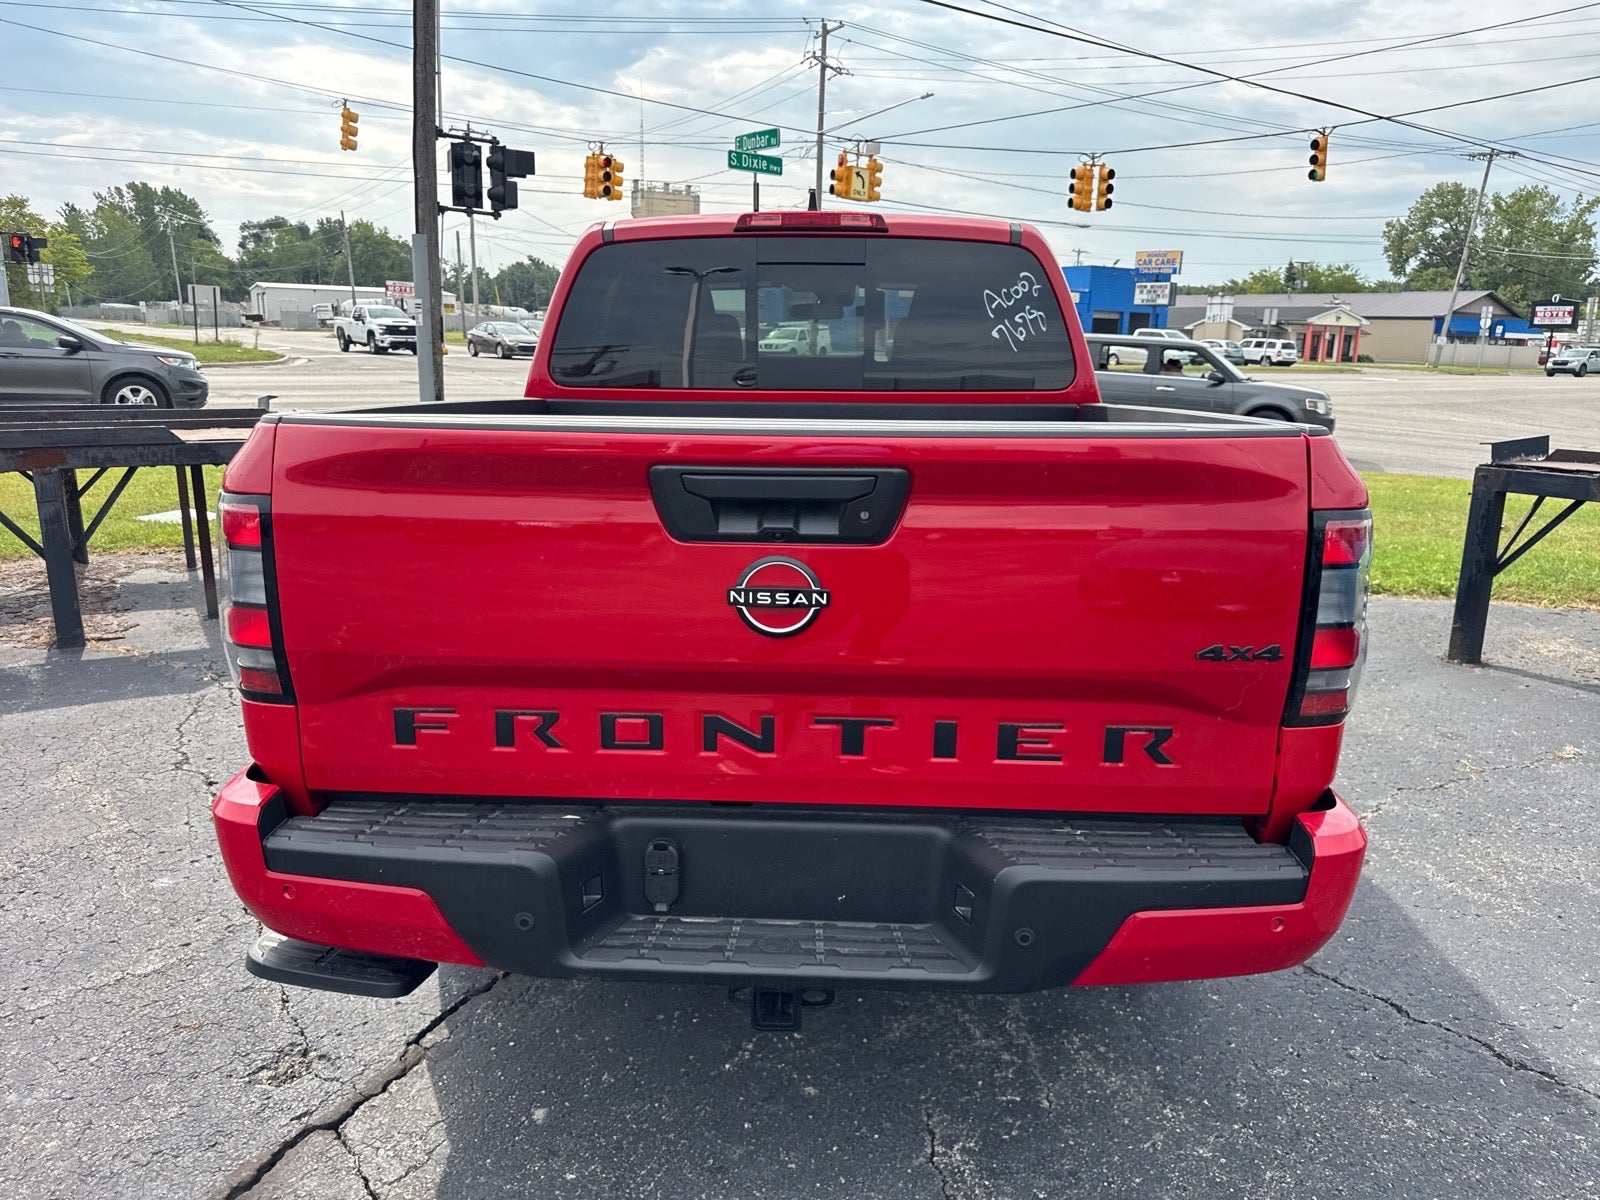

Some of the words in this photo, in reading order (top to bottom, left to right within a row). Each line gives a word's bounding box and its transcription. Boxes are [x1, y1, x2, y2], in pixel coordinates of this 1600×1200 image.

[742, 135, 769, 150] Dunbar
[730, 152, 740, 166] S.
[742, 154, 768, 170] Dixie
[769, 164, 781, 173] Hwy
[852, 188, 866, 197] ONLY
[1137, 258, 1152, 266] CAR
[1154, 258, 1176, 266] CARE
[991, 305, 1047, 352] 7678
[729, 590, 828, 606] NISSAN
[392, 707, 1176, 767] FRONTIER
